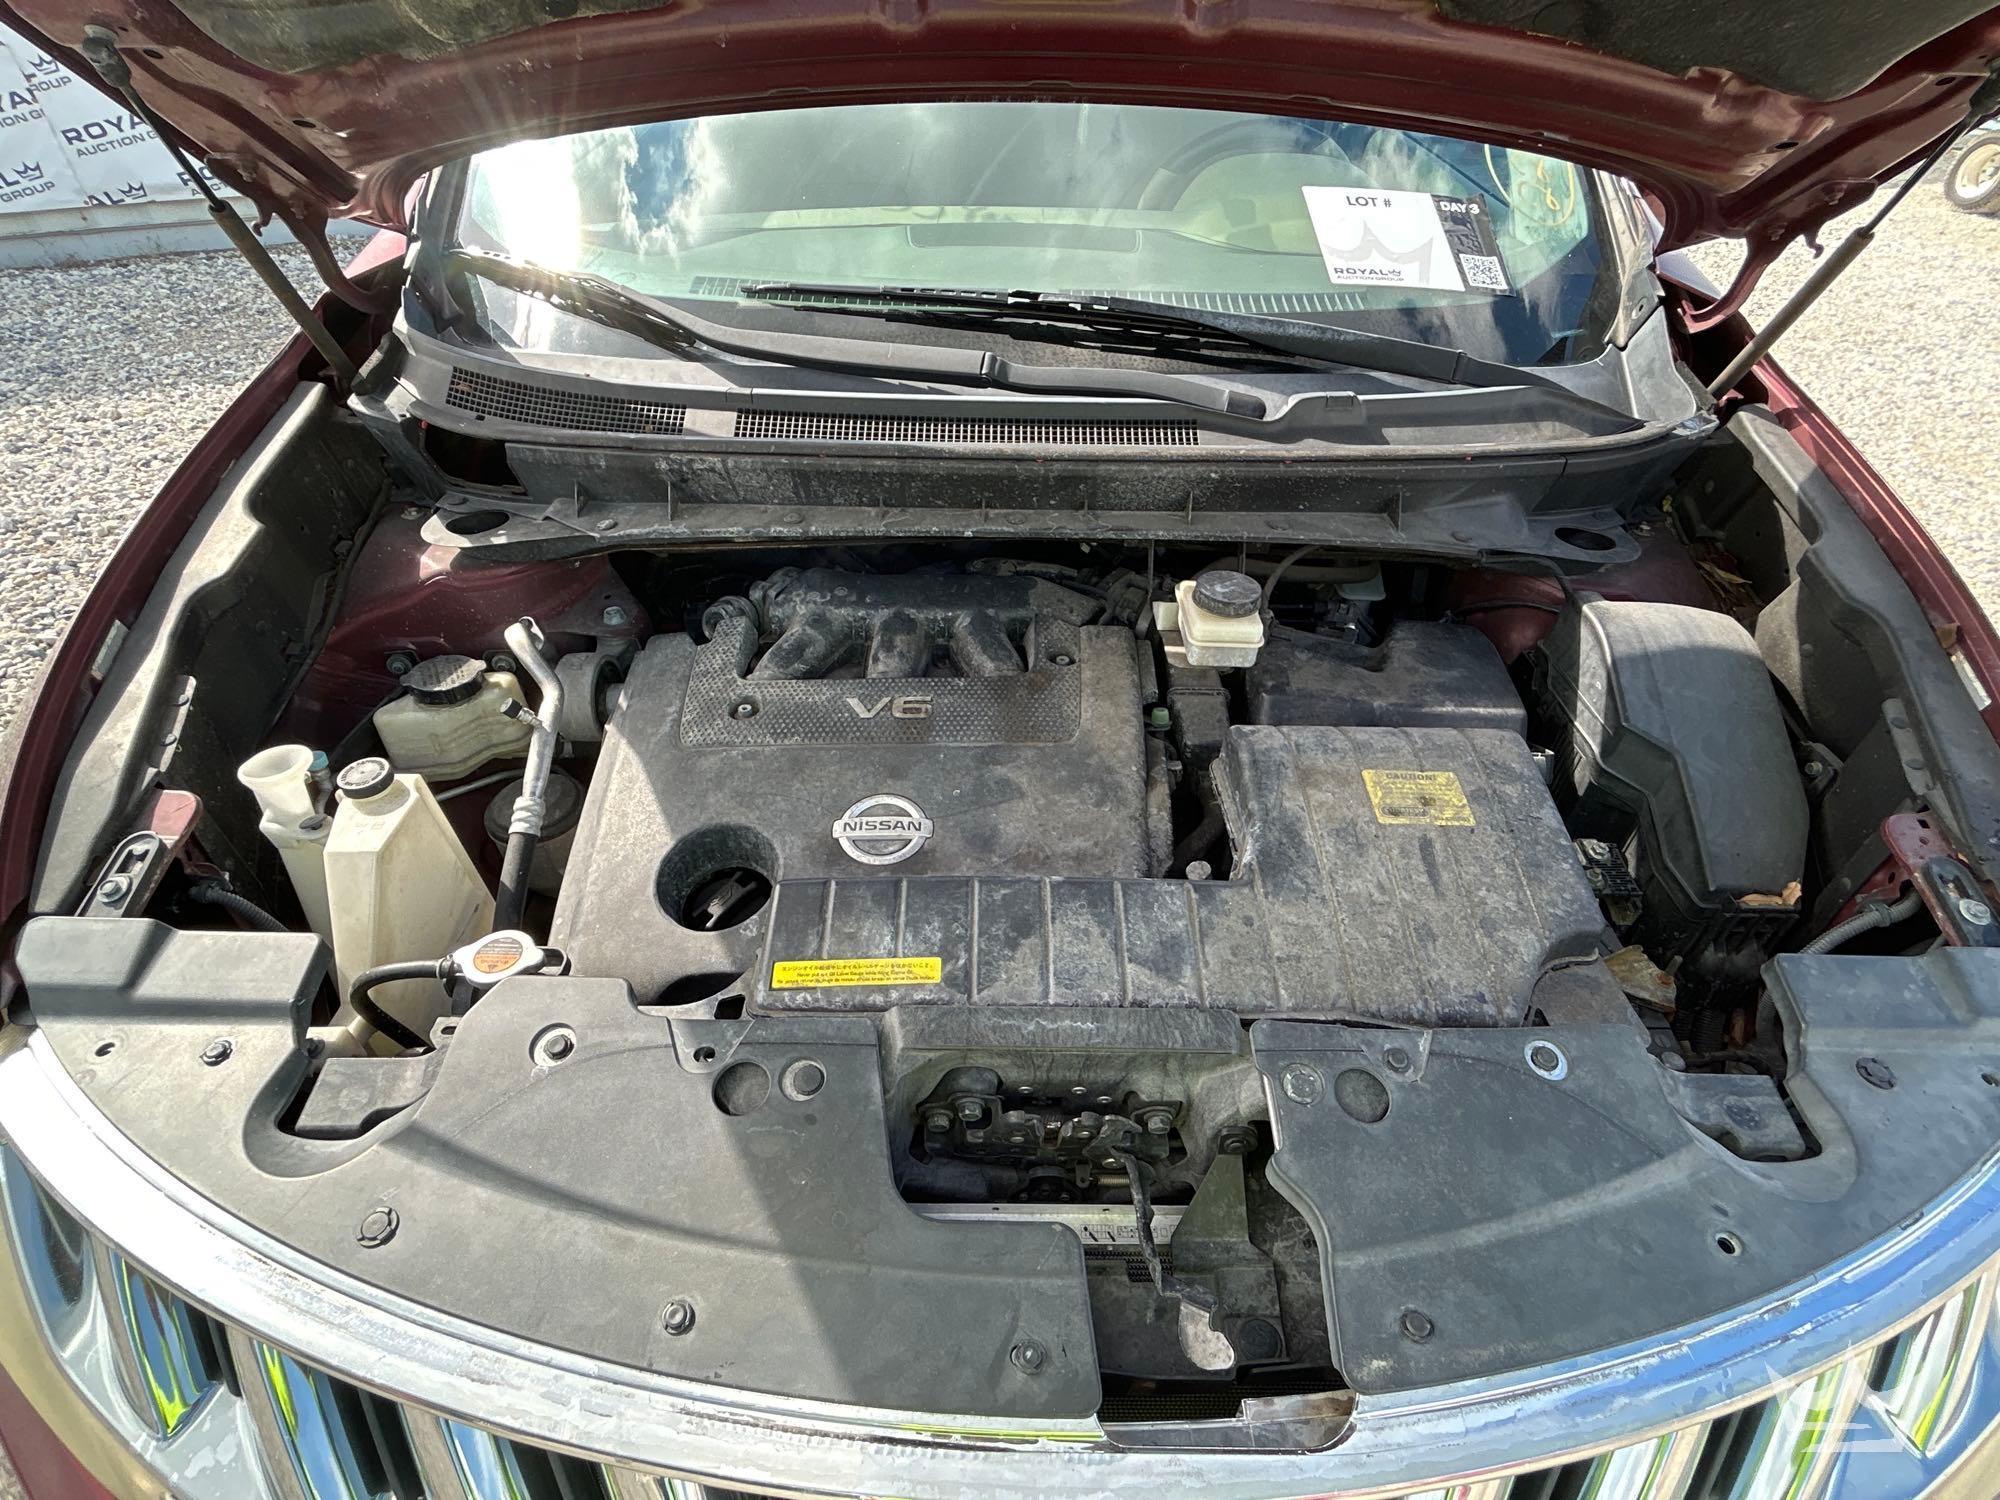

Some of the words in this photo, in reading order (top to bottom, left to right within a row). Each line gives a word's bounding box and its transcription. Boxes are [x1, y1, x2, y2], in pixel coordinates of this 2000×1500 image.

[77, 132, 146, 158] AUCTION
[1345, 196, 1378, 208] LOT
[1439, 201, 1467, 213] DAY
[1468, 203, 1480, 215] 3
[1333, 267, 1389, 276] ROYAL
[846, 695, 933, 719] V6
[843, 819, 923, 832] NISSAN
